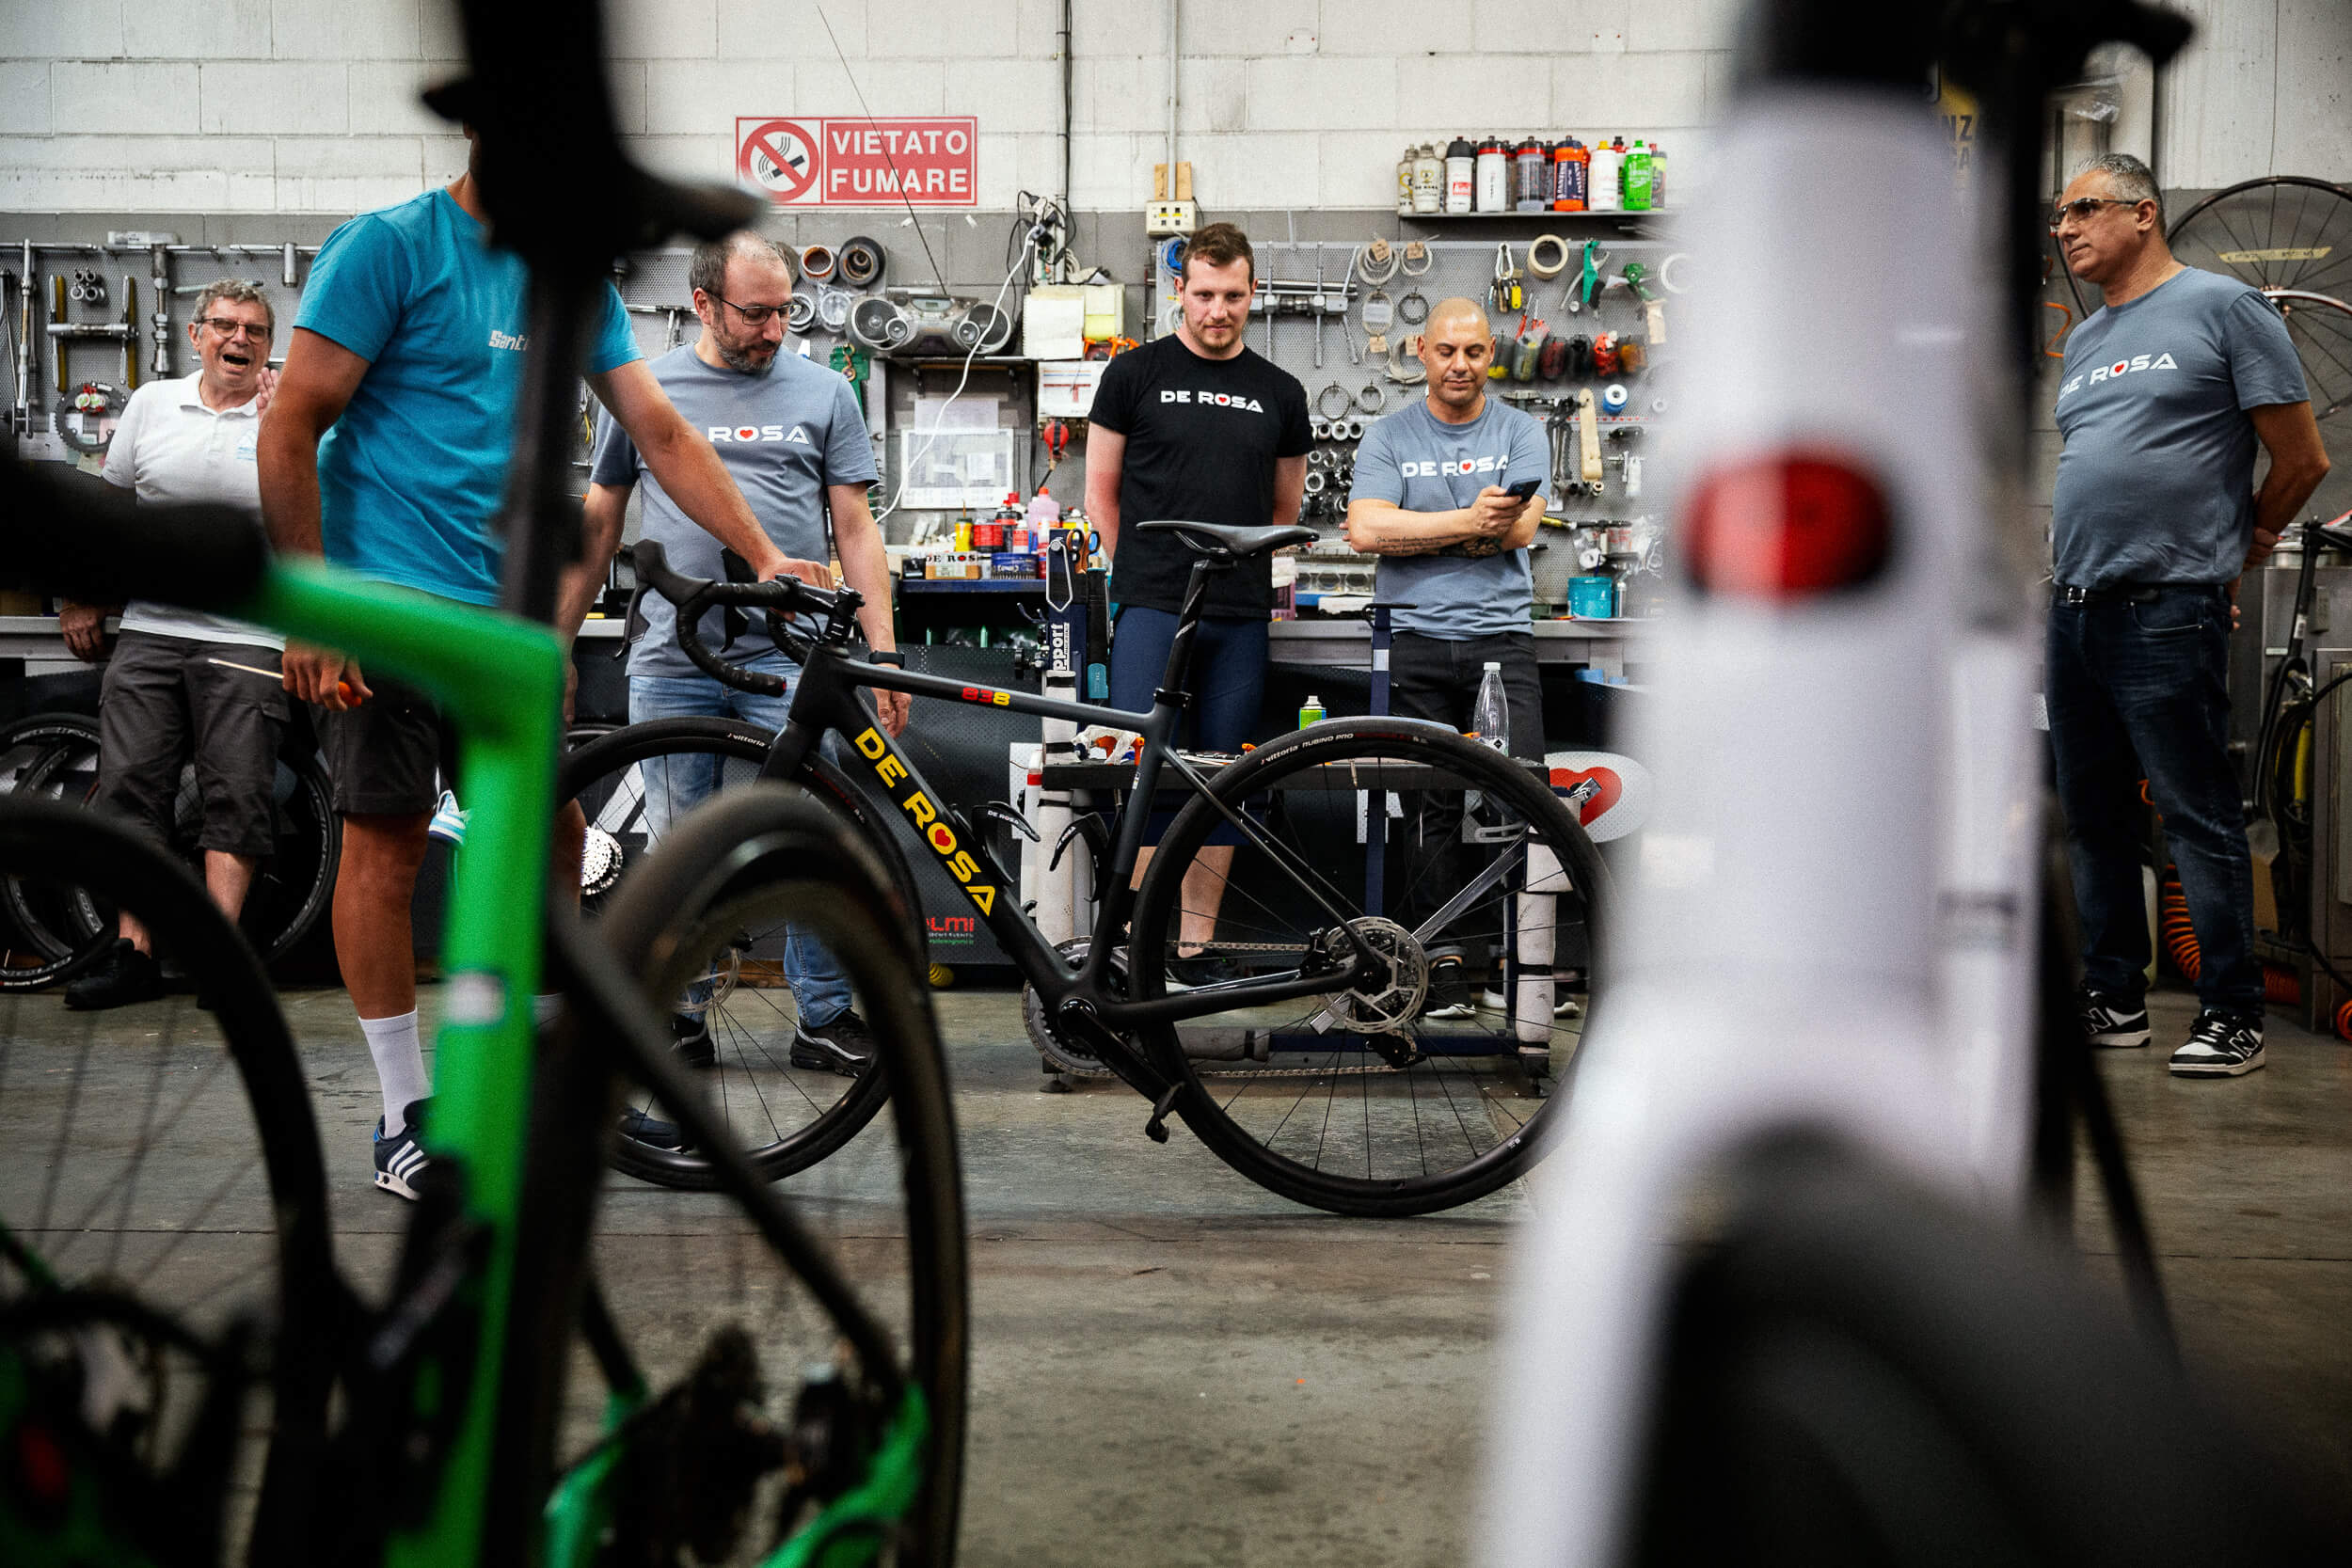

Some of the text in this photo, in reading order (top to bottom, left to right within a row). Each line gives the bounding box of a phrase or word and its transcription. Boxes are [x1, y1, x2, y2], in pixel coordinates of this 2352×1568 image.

[832, 129, 968, 155] VIETATO
[831, 167, 968, 194] FUMARE
[2089, 352, 2179, 386] ROSA
[1160, 389, 1264, 414] DE ROSA
[707, 424, 810, 445] ROSA
[1401, 454, 1510, 478] DE ROSA
[947, 554, 978, 563] ROS
[1050, 623, 1067, 671] pport
[961, 687, 1010, 706] 838
[1265, 744, 1299, 763] vittoria
[1335, 733, 1355, 741] PRO
[854, 726, 908, 788] DE
[902, 790, 996, 917] ROSA
